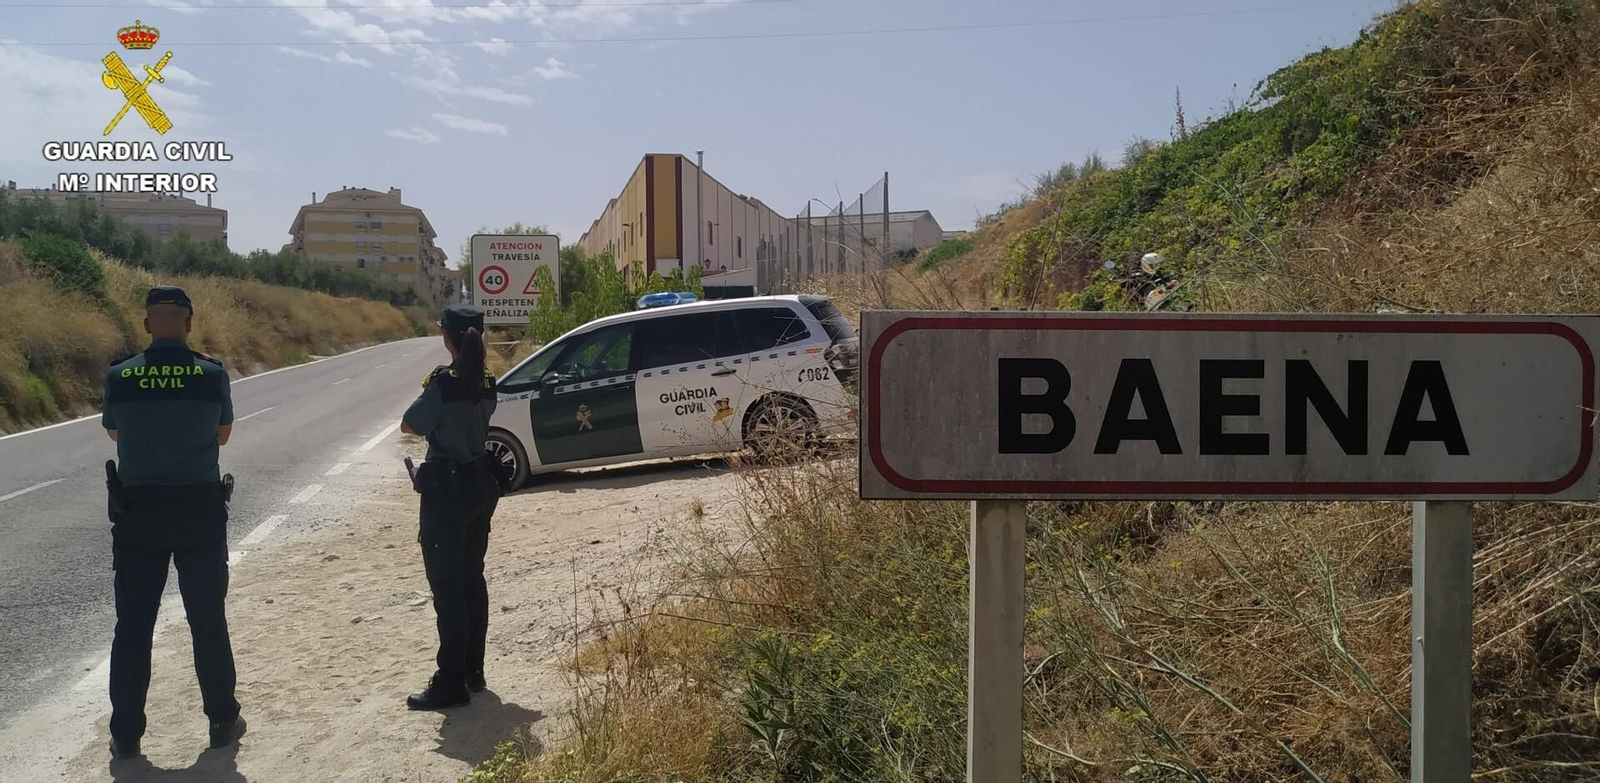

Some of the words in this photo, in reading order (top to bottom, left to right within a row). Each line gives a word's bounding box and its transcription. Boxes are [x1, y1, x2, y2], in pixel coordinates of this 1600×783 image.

[489, 241, 542, 250] ATENCIÓN
[492, 252, 540, 261] TRAVESÍA
[485, 275, 503, 285] 40
[481, 298, 534, 306] RESPETEN
[482, 308, 529, 317] EÑALIZA
[121, 365, 204, 378] GUARDIA
[807, 367, 830, 382] 062
[139, 378, 185, 389] CIVIL
[659, 386, 717, 404] GUARDIA
[674, 402, 706, 417] CIVIL
[997, 357, 1470, 456] BAENA
